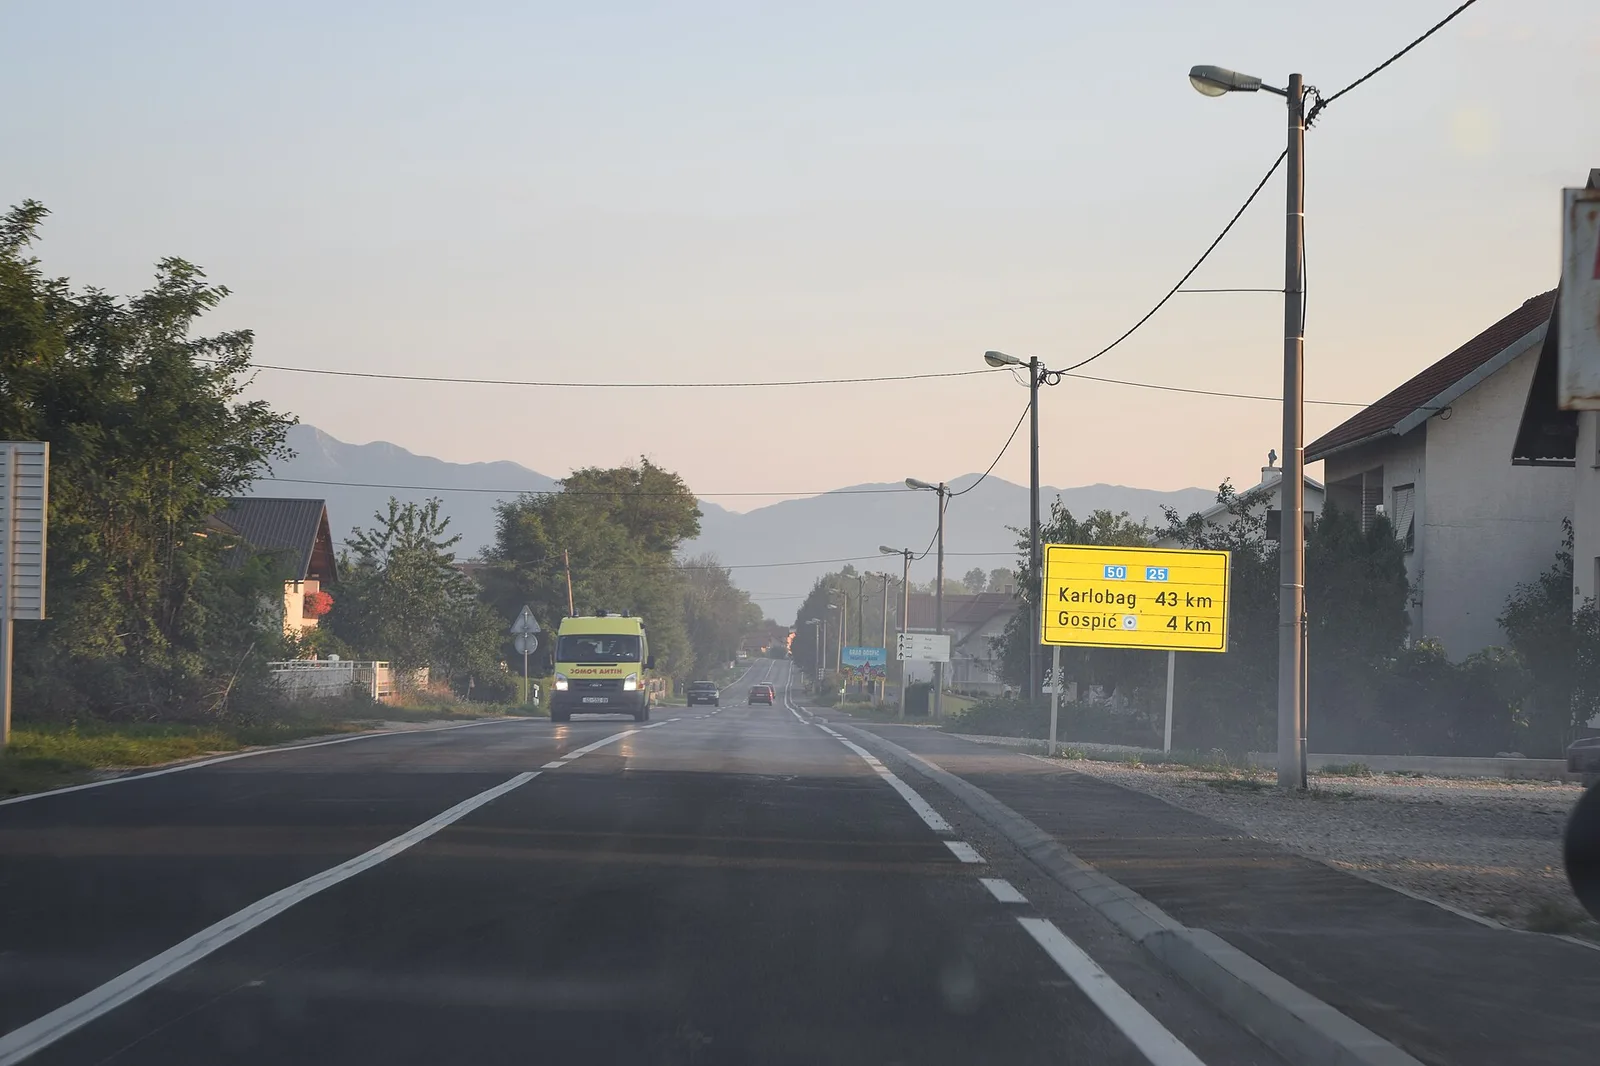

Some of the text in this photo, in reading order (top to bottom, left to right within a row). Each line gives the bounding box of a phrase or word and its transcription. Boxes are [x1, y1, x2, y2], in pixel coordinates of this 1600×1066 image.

[1107, 567, 1165, 580] 50 25
[1059, 587, 1212, 609] Karlobag 43 km
[1058, 611, 1211, 632] Gospić 4 km
